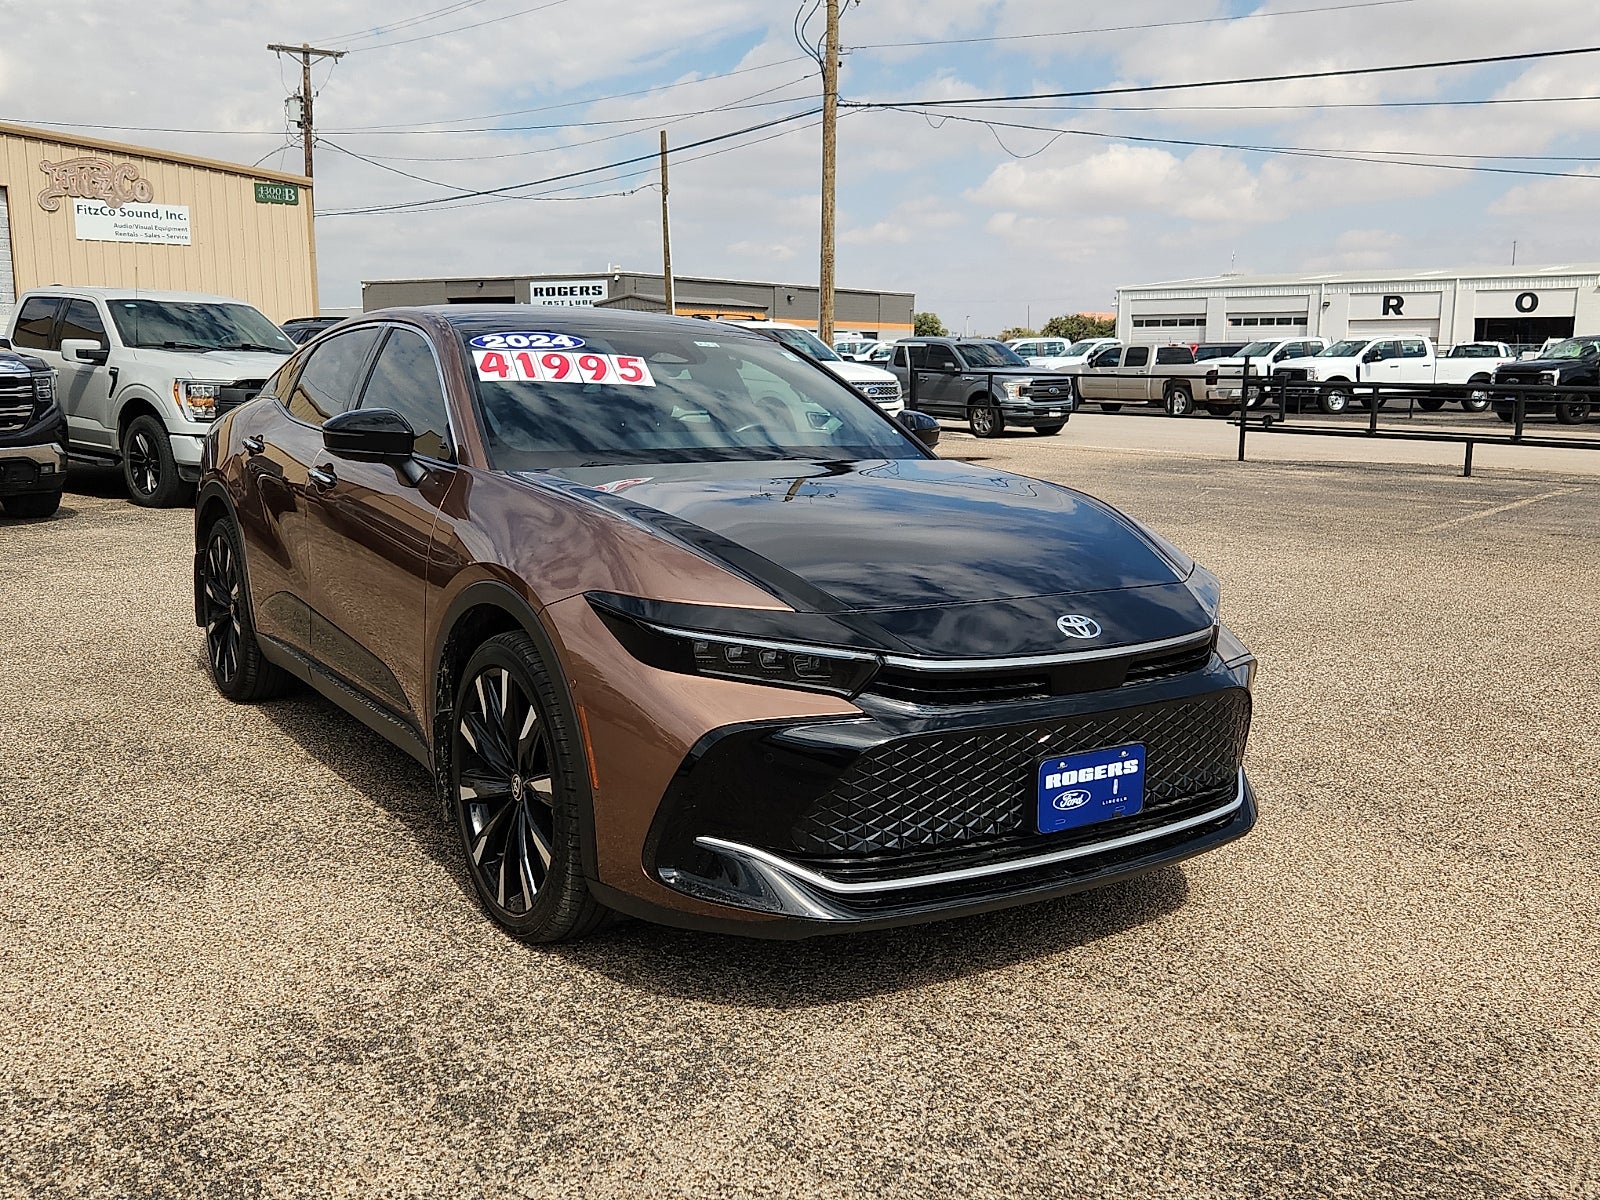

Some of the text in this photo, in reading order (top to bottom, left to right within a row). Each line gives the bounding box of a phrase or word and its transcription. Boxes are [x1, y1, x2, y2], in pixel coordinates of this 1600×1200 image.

[285, 188, 296, 201] B
[76, 204, 187, 221] FitzCo Sound, Inc.
[113, 222, 188, 233] Audio/Visual Equipment
[114, 230, 139, 238] Rentals
[533, 285, 603, 297] ROGERS
[1382, 292, 1539, 316] R O
[482, 334, 575, 348] 2024
[479, 351, 643, 382] 41995
[1045, 758, 1139, 790] ROGERS
[1059, 792, 1085, 808] Ford
